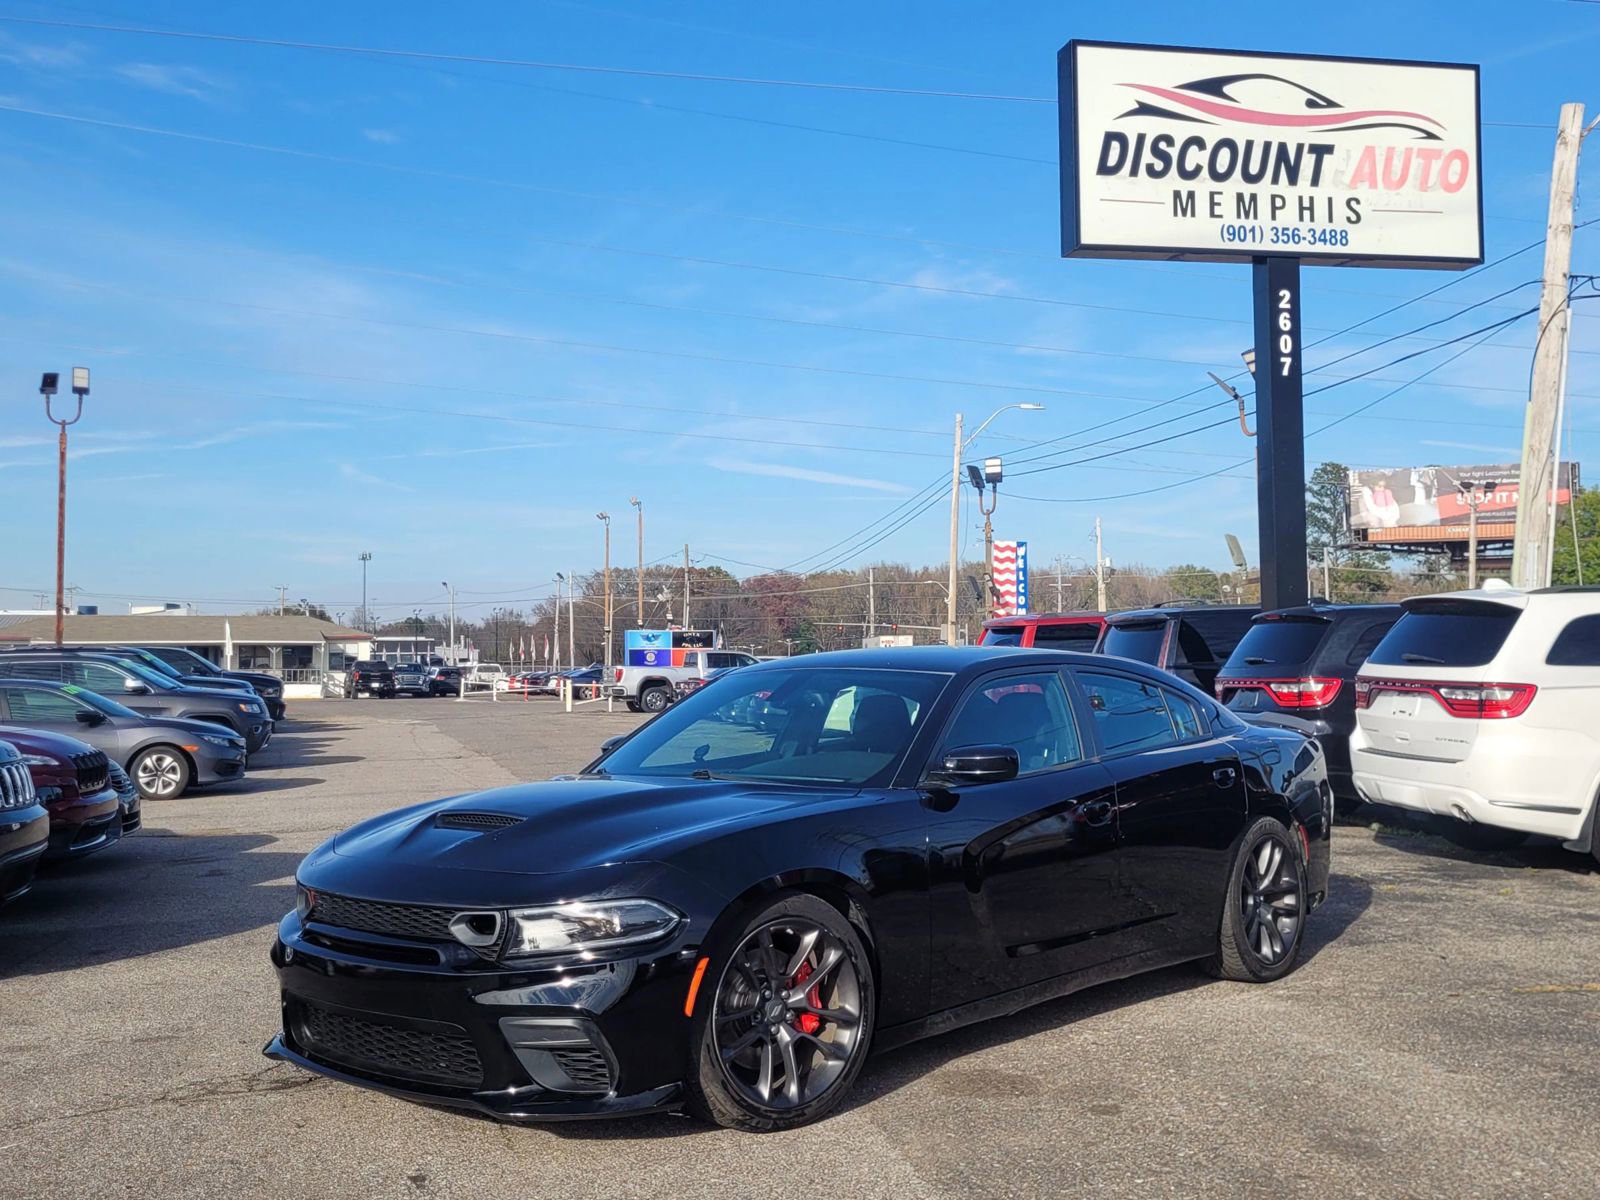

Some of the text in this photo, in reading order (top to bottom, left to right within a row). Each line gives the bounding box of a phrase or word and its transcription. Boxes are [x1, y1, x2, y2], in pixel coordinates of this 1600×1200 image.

[1096, 131, 1470, 193] DISCOUNT AUTO
[1172, 190, 1362, 225] MEMPHIS
[1220, 224, 1349, 247] (901) 356-3488
[1278, 289, 1292, 376] 2607
